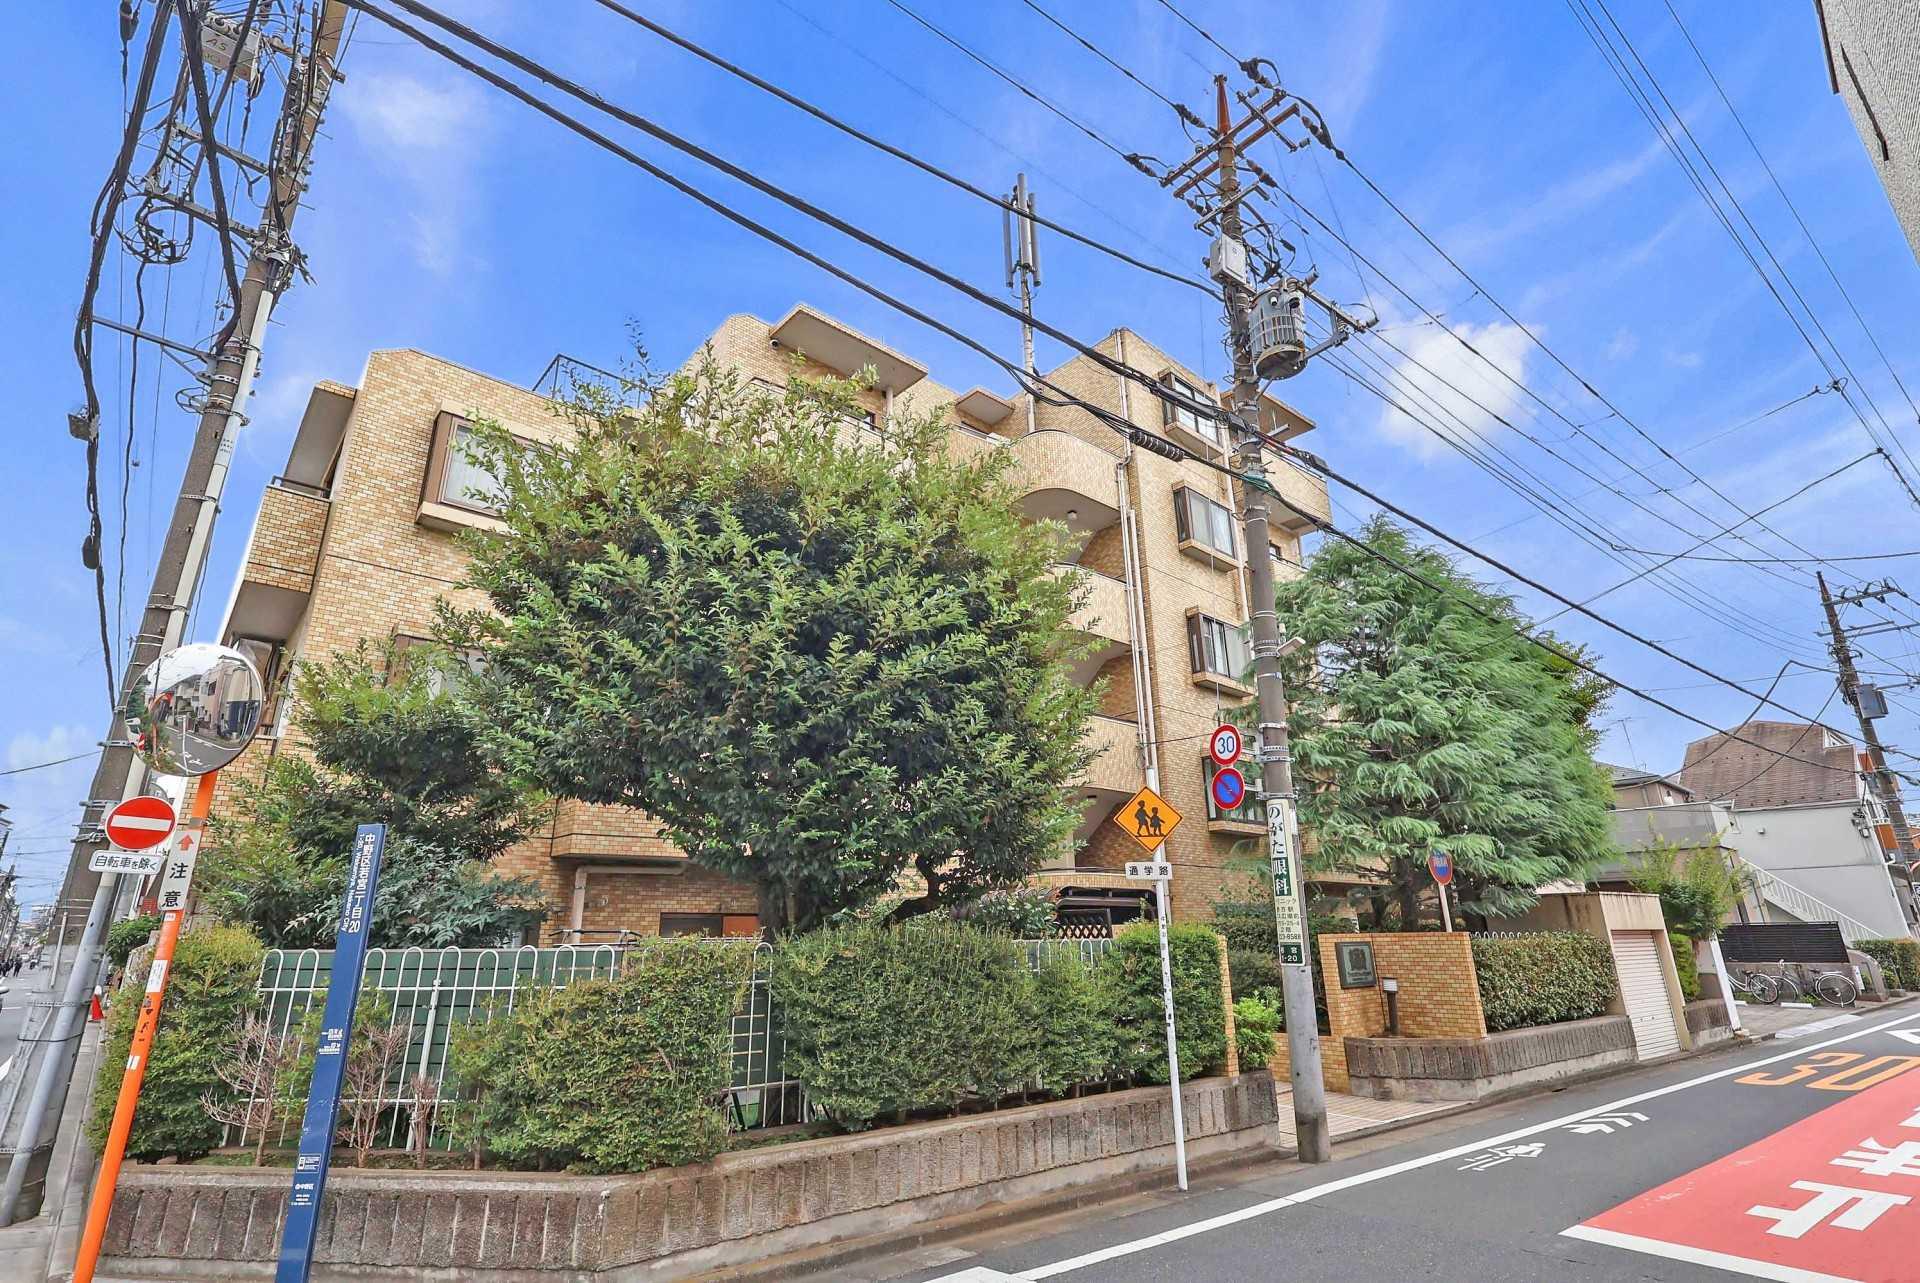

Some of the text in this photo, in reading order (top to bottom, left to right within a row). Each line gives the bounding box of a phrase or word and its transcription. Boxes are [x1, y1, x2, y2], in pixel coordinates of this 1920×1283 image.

[1217, 735, 1235, 754] 30
[94, 854, 158, 871] 自転車を除く
[1129, 865, 1168, 876] 通学路
[161, 862, 189, 908] 注意
[1734, 1052, 1920, 1091] 30
